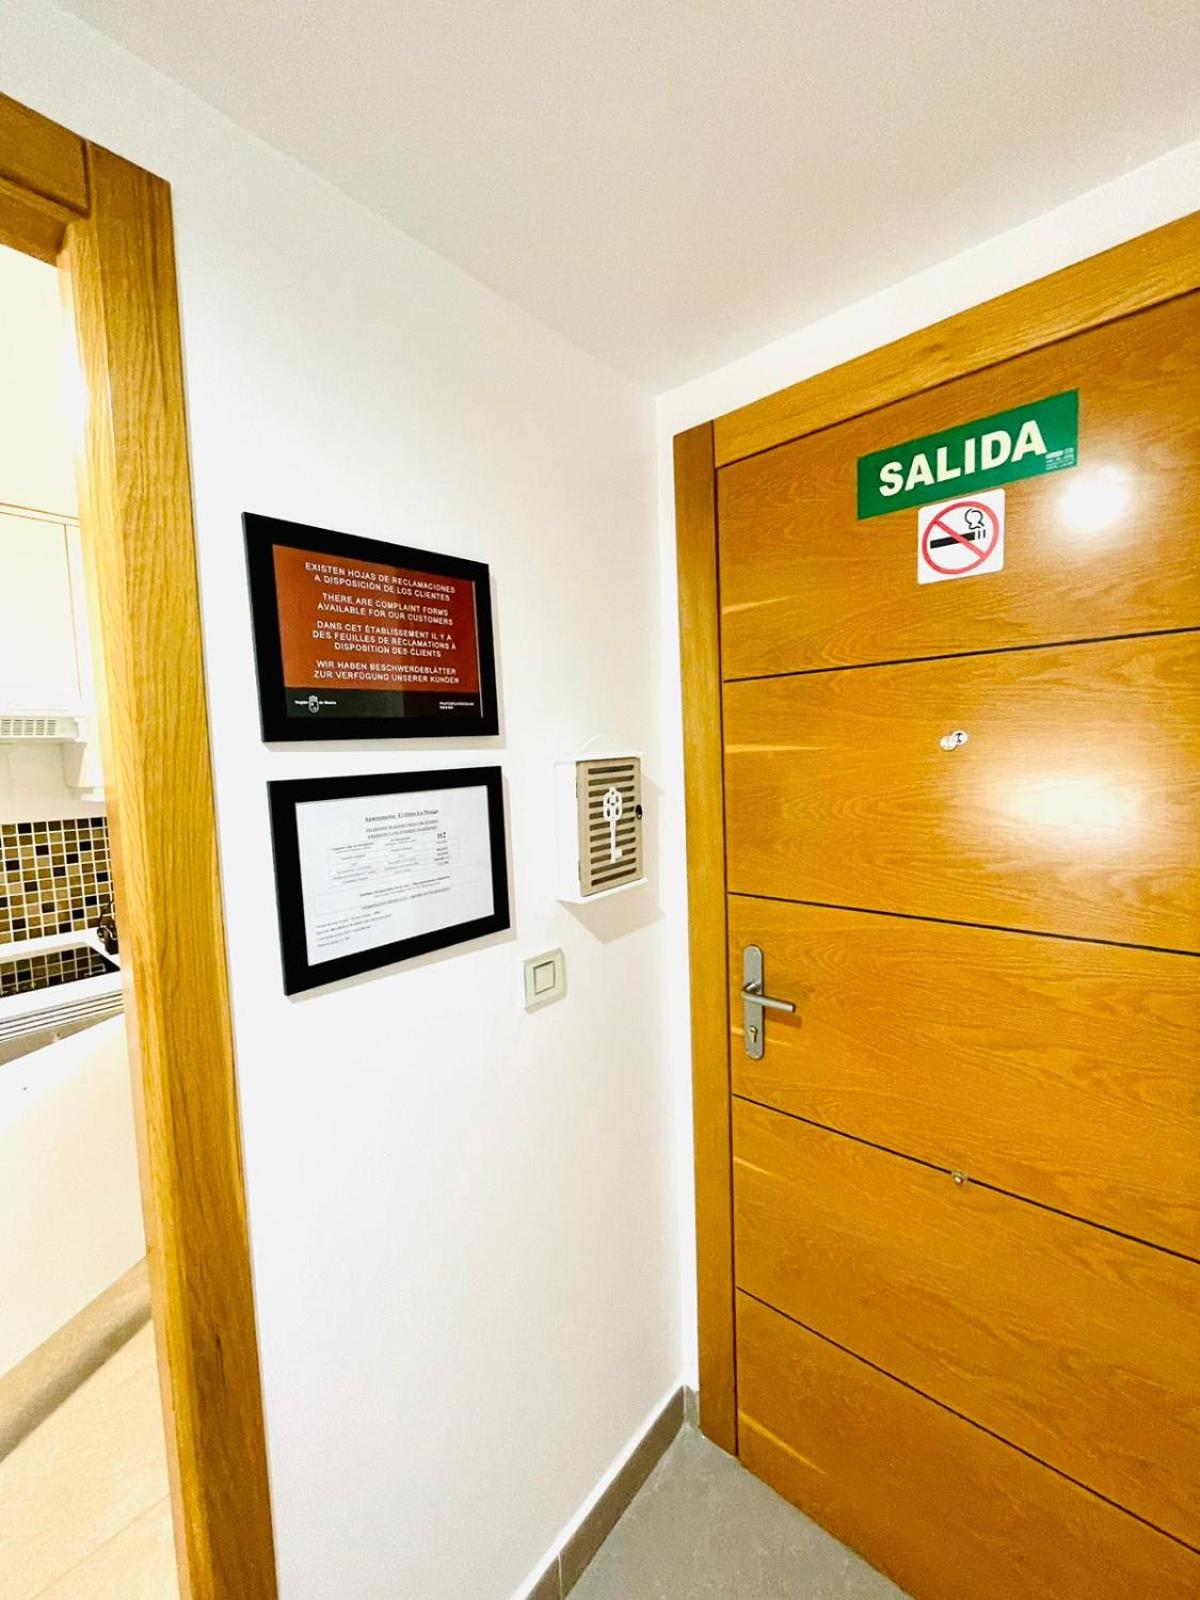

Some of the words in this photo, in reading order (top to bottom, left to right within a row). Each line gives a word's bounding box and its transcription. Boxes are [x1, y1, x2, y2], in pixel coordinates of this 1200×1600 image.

[879, 419, 1048, 497] SALIDA
[305, 562, 346, 576] EXISTEN
[347, 568, 377, 581] HOJAS
[378, 574, 390, 584] DE
[392, 577, 456, 594] RECLAMACIONES
[314, 574, 322, 583] A
[324, 575, 382, 591] DISPOSICIÓN
[383, 584, 396, 594] DE
[396, 586, 413, 596] LOS
[414, 589, 450, 601] CLIENTES
[317, 602, 367, 616] AVAILABLE
[368, 609, 386, 618] FOR
[388, 611, 406, 620] OUR
[407, 614, 454, 626] CUSTOMERS
[322, 592, 353, 604] THERE
[355, 597, 372, 607] ARE
[375, 600, 421, 613] COMPLAINT
[422, 606, 449, 617] FORMS
[312, 630, 333, 640] DES
[334, 632, 376, 643] FEUILLES
[378, 636, 389, 645] DE
[317, 620, 343, 631] DANS
[344, 624, 363, 633] CET
[431, 631, 439, 640] IL
[446, 633, 453, 641] A
[334, 642, 390, 655] DISPOSITION
[391, 647, 409, 656] DES
[410, 649, 442, 659] CLIENTS
[316, 660, 335, 669] WIR
[337, 661, 367, 671] HABEN
[313, 670, 334, 679] ZUR
[335, 671, 390, 682] VERFÜGUNG
[391, 673, 428, 683] UNSERER
[430, 675, 460, 685] KUNDEN
